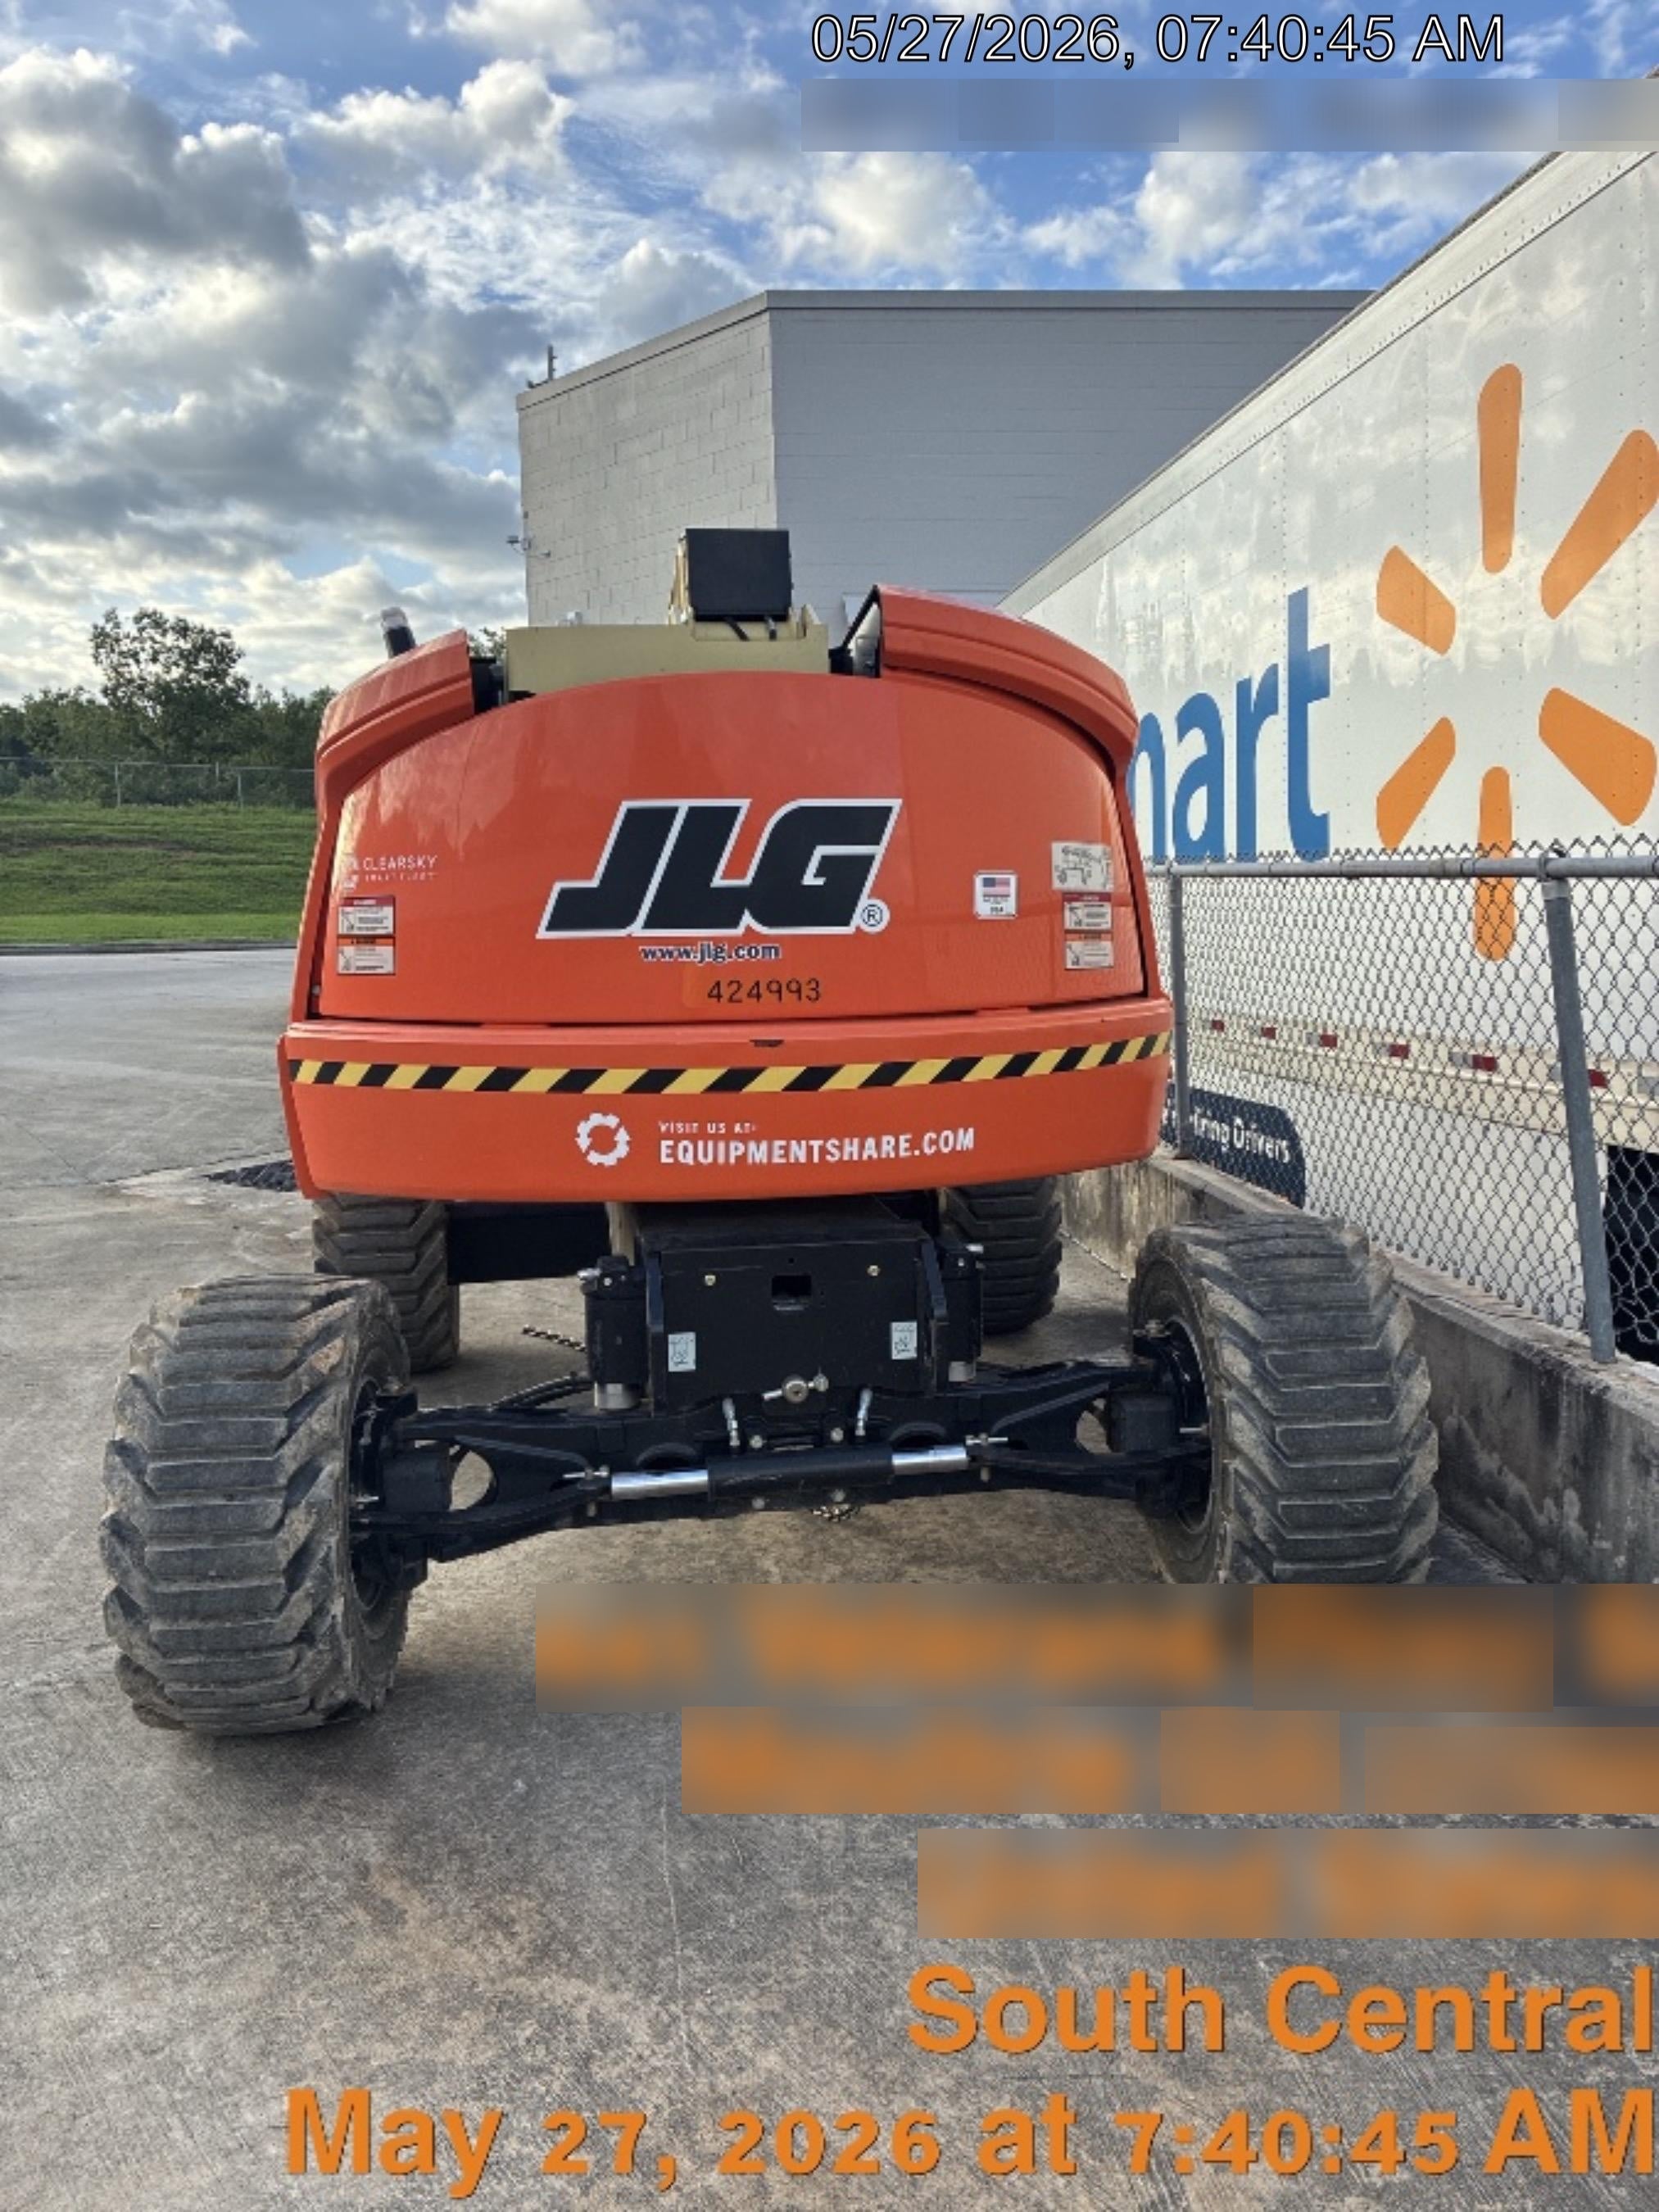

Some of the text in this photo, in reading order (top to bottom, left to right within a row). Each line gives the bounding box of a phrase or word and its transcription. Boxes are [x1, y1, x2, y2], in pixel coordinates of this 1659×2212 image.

[362, 854, 437, 870] CLEARSKY
[640, 941, 781, 965] www.jlg.com
[707, 977, 822, 1004] 424993
[658, 1121, 699, 1134] VISIT
[707, 1122, 726, 1134] US
[660, 1127, 975, 1165] EQUIPMENTSHARE.COM
